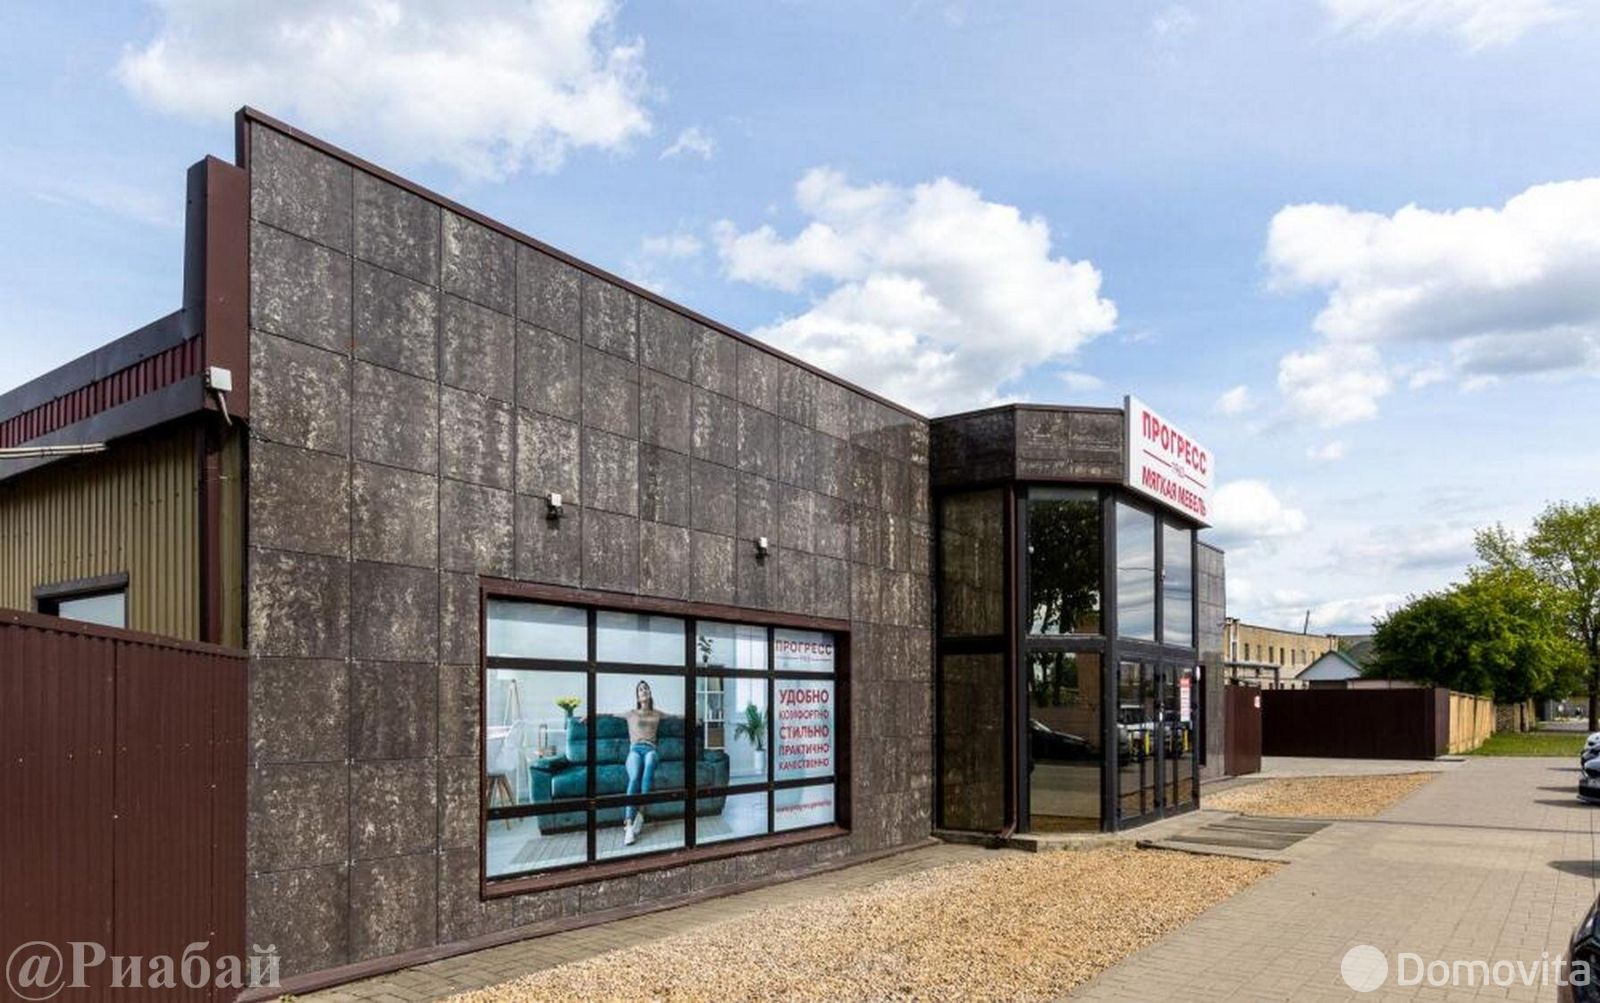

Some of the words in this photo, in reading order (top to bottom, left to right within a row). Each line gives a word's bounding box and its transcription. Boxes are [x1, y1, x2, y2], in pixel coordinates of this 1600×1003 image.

[1142, 410, 1207, 475] ПРОГРЕСС
[1142, 466, 1177, 501] МЯГКАЯ
[1177, 485, 1207, 517] МЕБЕЛЬ
[775, 639, 832, 655] ПРОГРЕСС
[779, 689, 829, 706] УДОБНО
[779, 725, 829, 740] СТИЛЬНО
[779, 743, 829, 756] ПРАКТИЧНО
